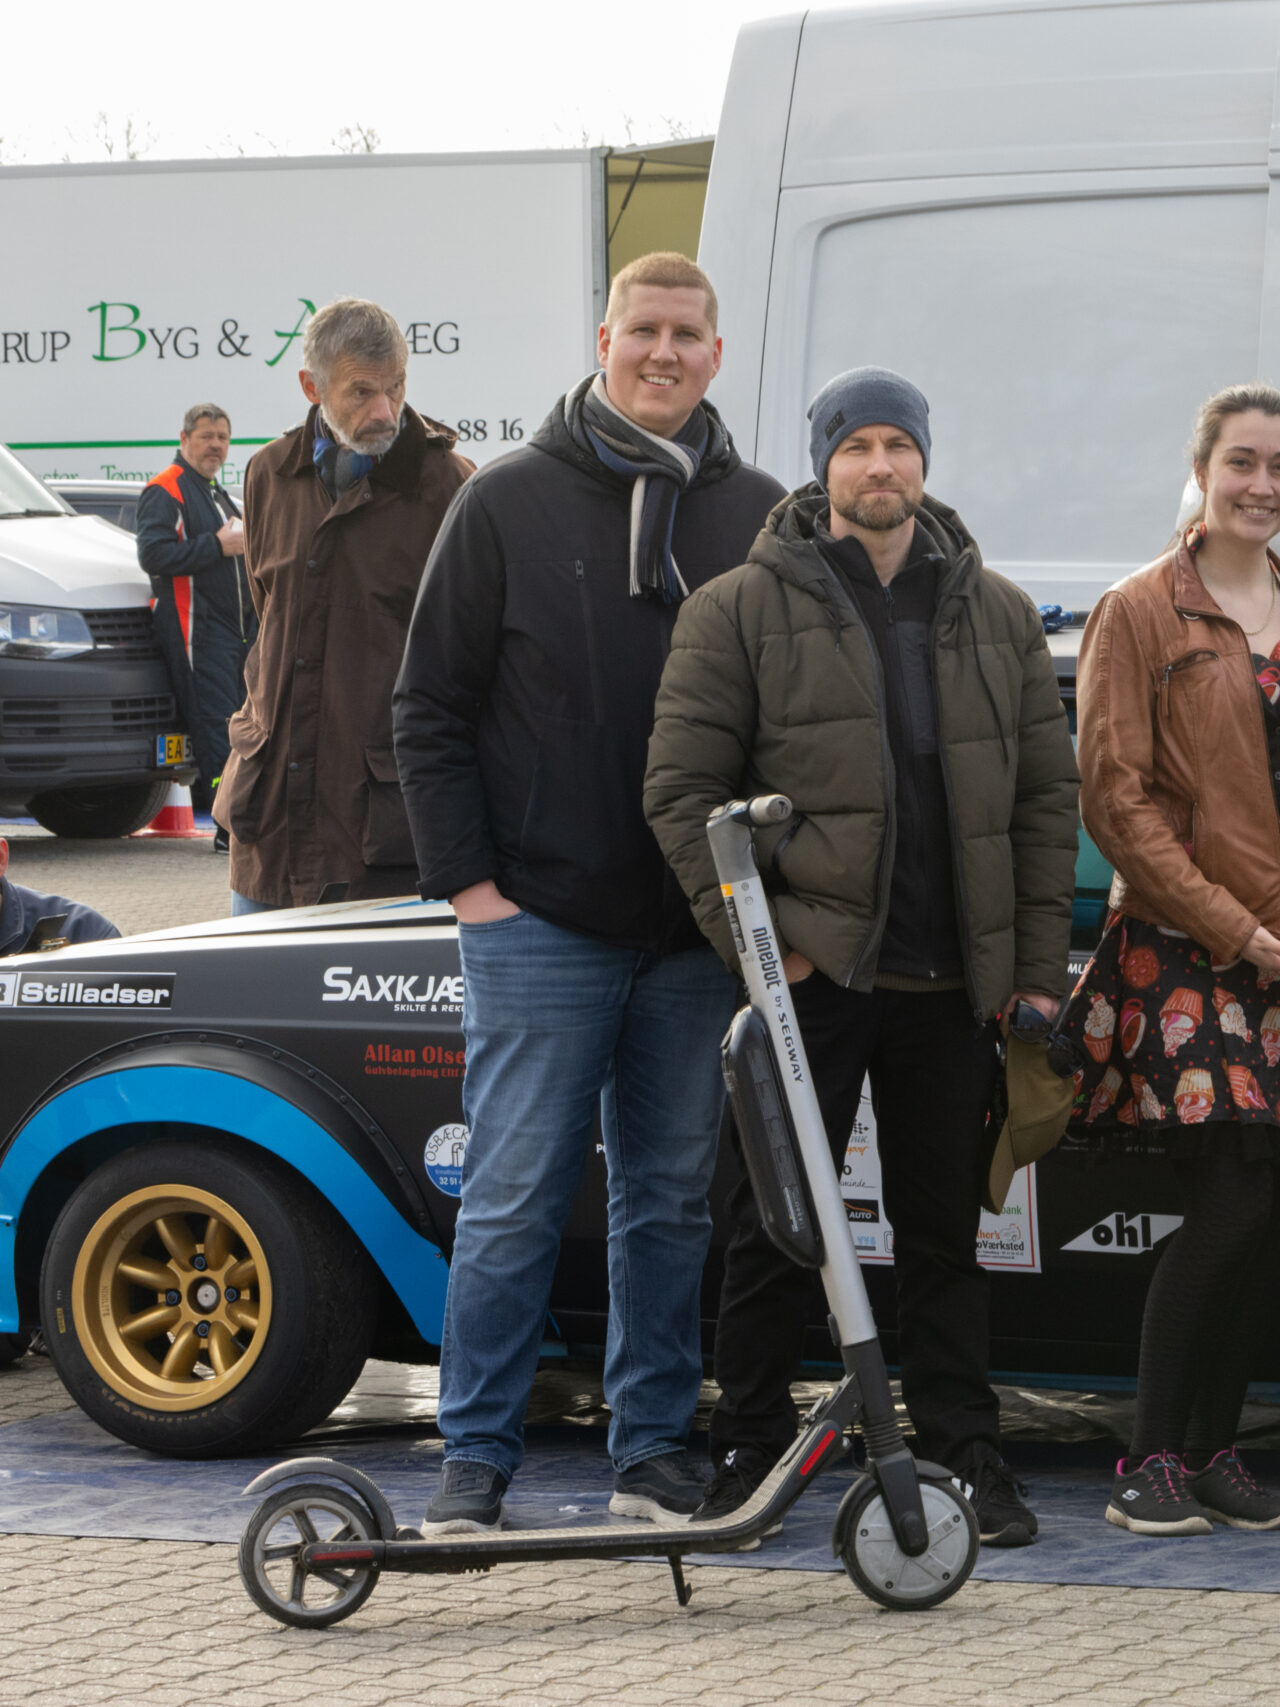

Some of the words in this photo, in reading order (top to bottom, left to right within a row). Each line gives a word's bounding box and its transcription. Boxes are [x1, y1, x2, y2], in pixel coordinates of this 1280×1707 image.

[217, 318, 252, 357] &
[499, 418, 524, 441] 16
[752, 926, 782, 989] ninebot
[21, 982, 170, 1005] Stilladser
[774, 995, 783, 1009] by
[393, 1004, 426, 1012] SKILTE
[430, 1004, 437, 1012] &
[364, 1044, 416, 1063] Allan
[777, 1012, 804, 1083] SEGWAY
[848, 1211, 873, 1220] AUTO
